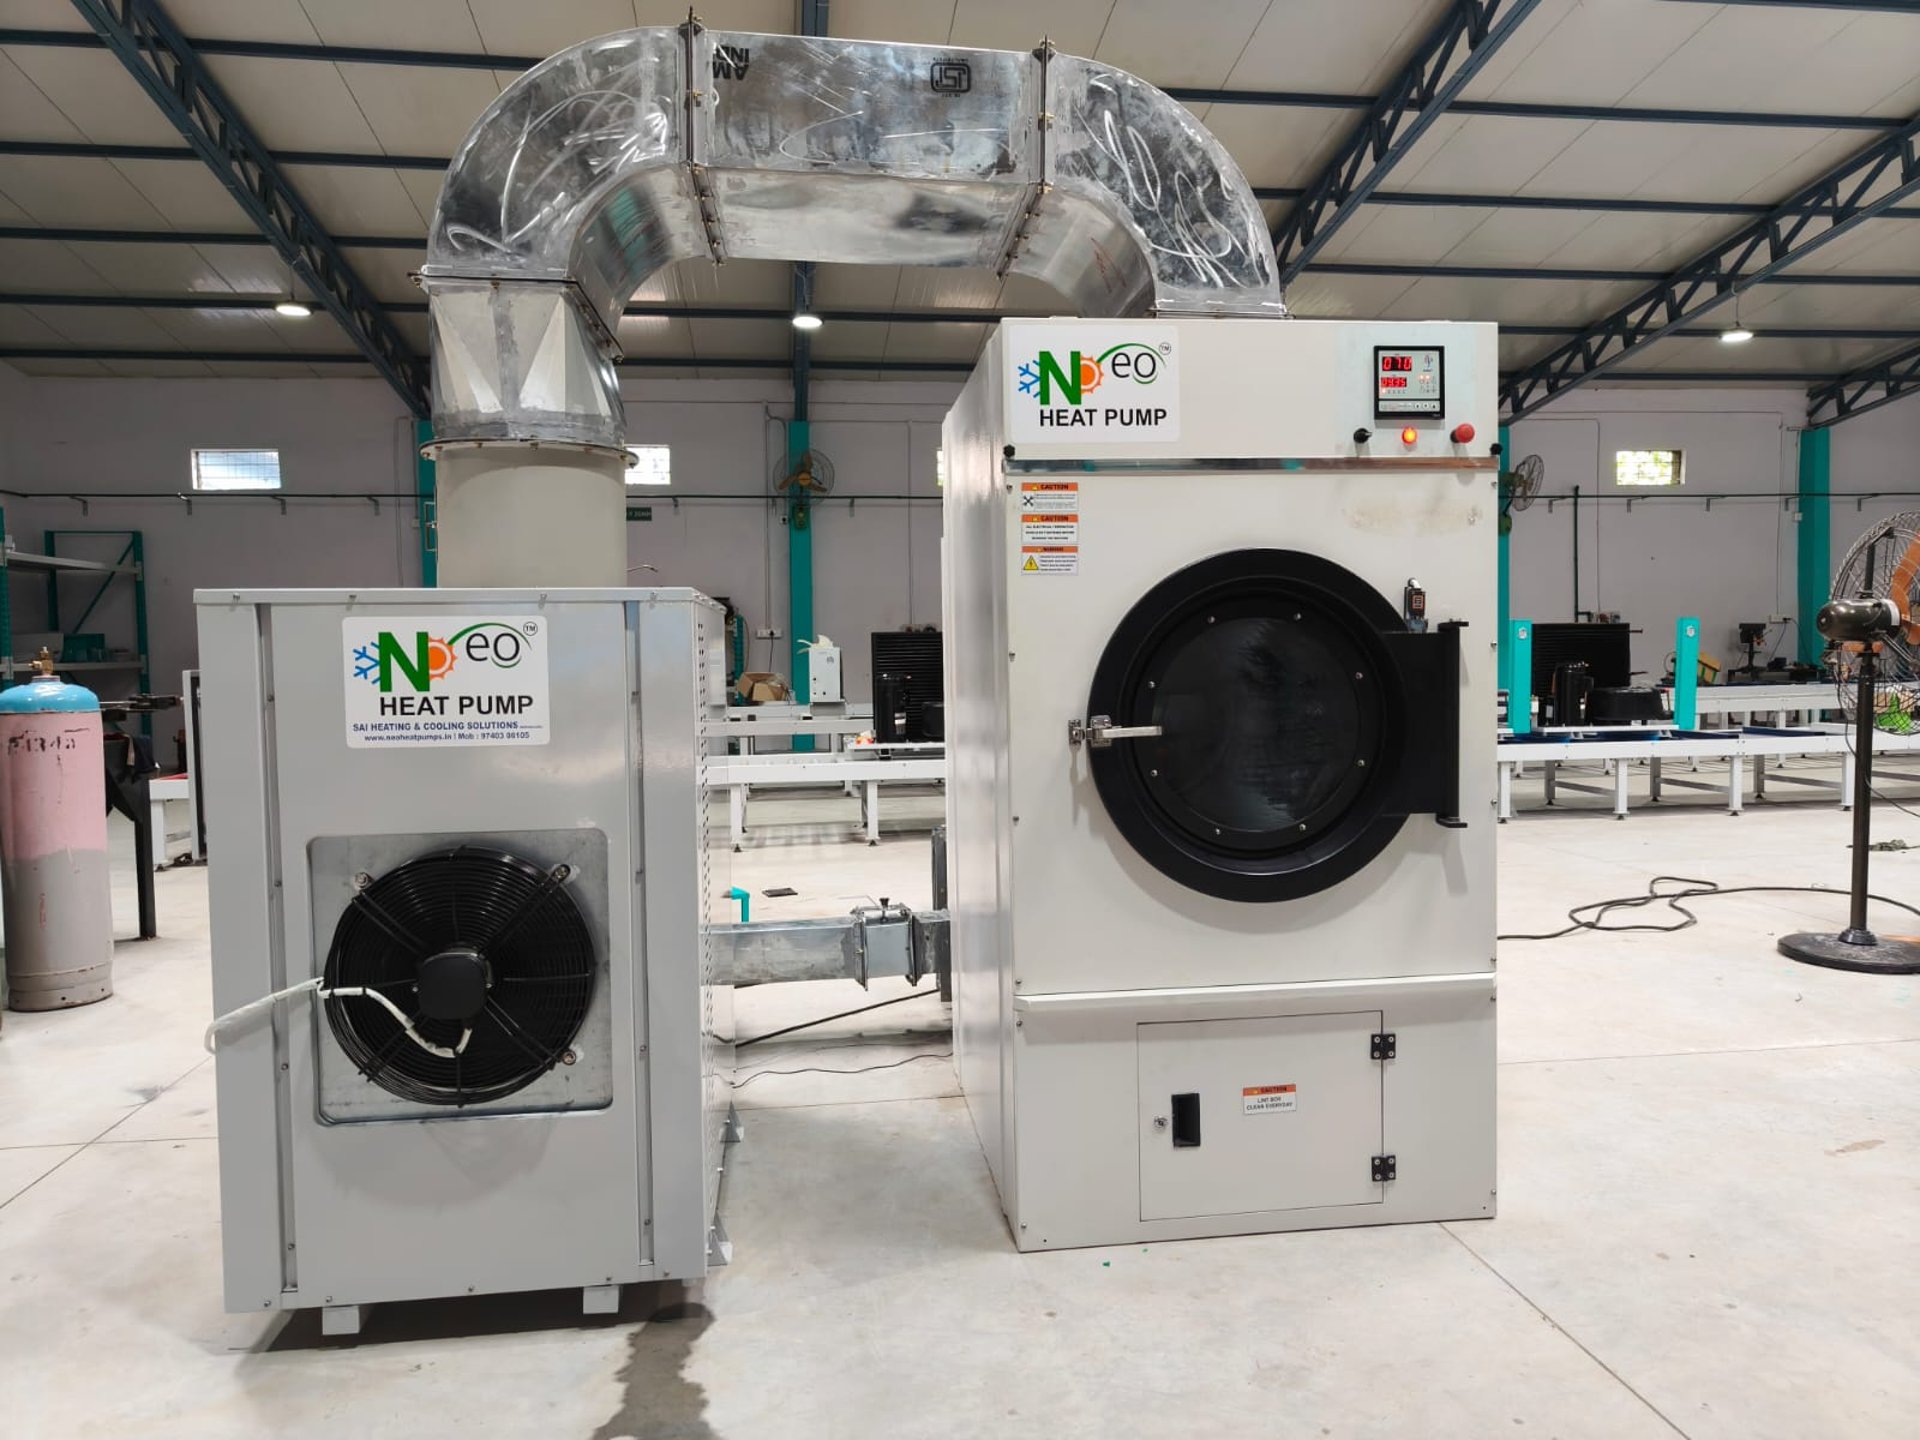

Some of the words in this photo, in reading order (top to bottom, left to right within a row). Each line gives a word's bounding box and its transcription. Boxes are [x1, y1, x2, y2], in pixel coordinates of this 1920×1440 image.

[1040, 408, 1098, 427] HEAT
[1105, 408, 1167, 426] PUMP
[380, 696, 449, 716] HEAT
[459, 695, 533, 715] PUMP
[353, 723, 369, 732] SAI
[371, 723, 411, 731] HEATING
[414, 723, 421, 731] &
[423, 722, 464, 731] COOLING
[467, 721, 518, 730] SOLUTIONS
[364, 733, 452, 742] www.neoheatpumps.in
[458, 732, 474, 740] Mob
